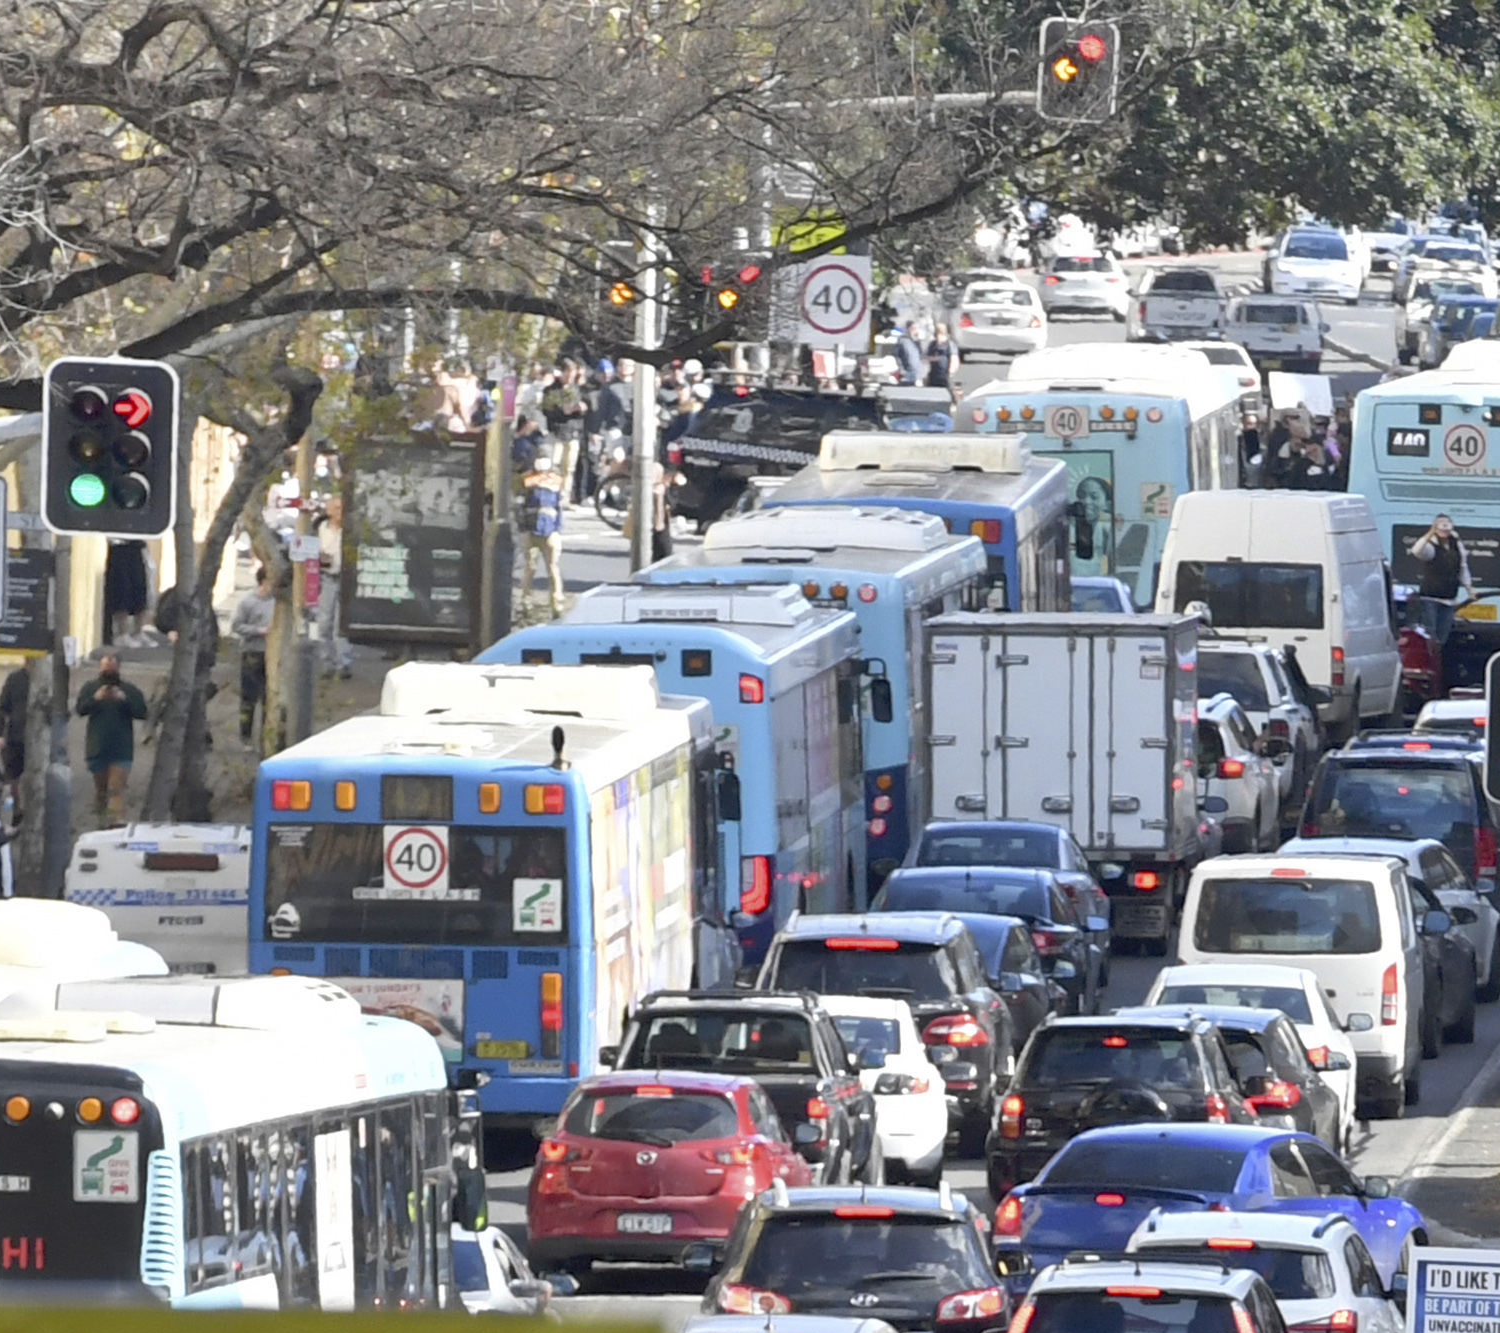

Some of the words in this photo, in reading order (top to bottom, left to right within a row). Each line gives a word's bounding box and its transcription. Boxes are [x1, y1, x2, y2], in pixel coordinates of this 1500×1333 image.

[812, 285, 857, 314] 40
[1057, 413, 1077, 431] 40
[1450, 435, 1478, 457] 40
[396, 843, 437, 872] 40
[1430, 1269, 1451, 1288] I'D
[1457, 1271, 1489, 1290] LIKE
[1424, 1298, 1439, 1313] BE
[1442, 1299, 1473, 1314] PART
[1475, 1301, 1490, 1315] OF
